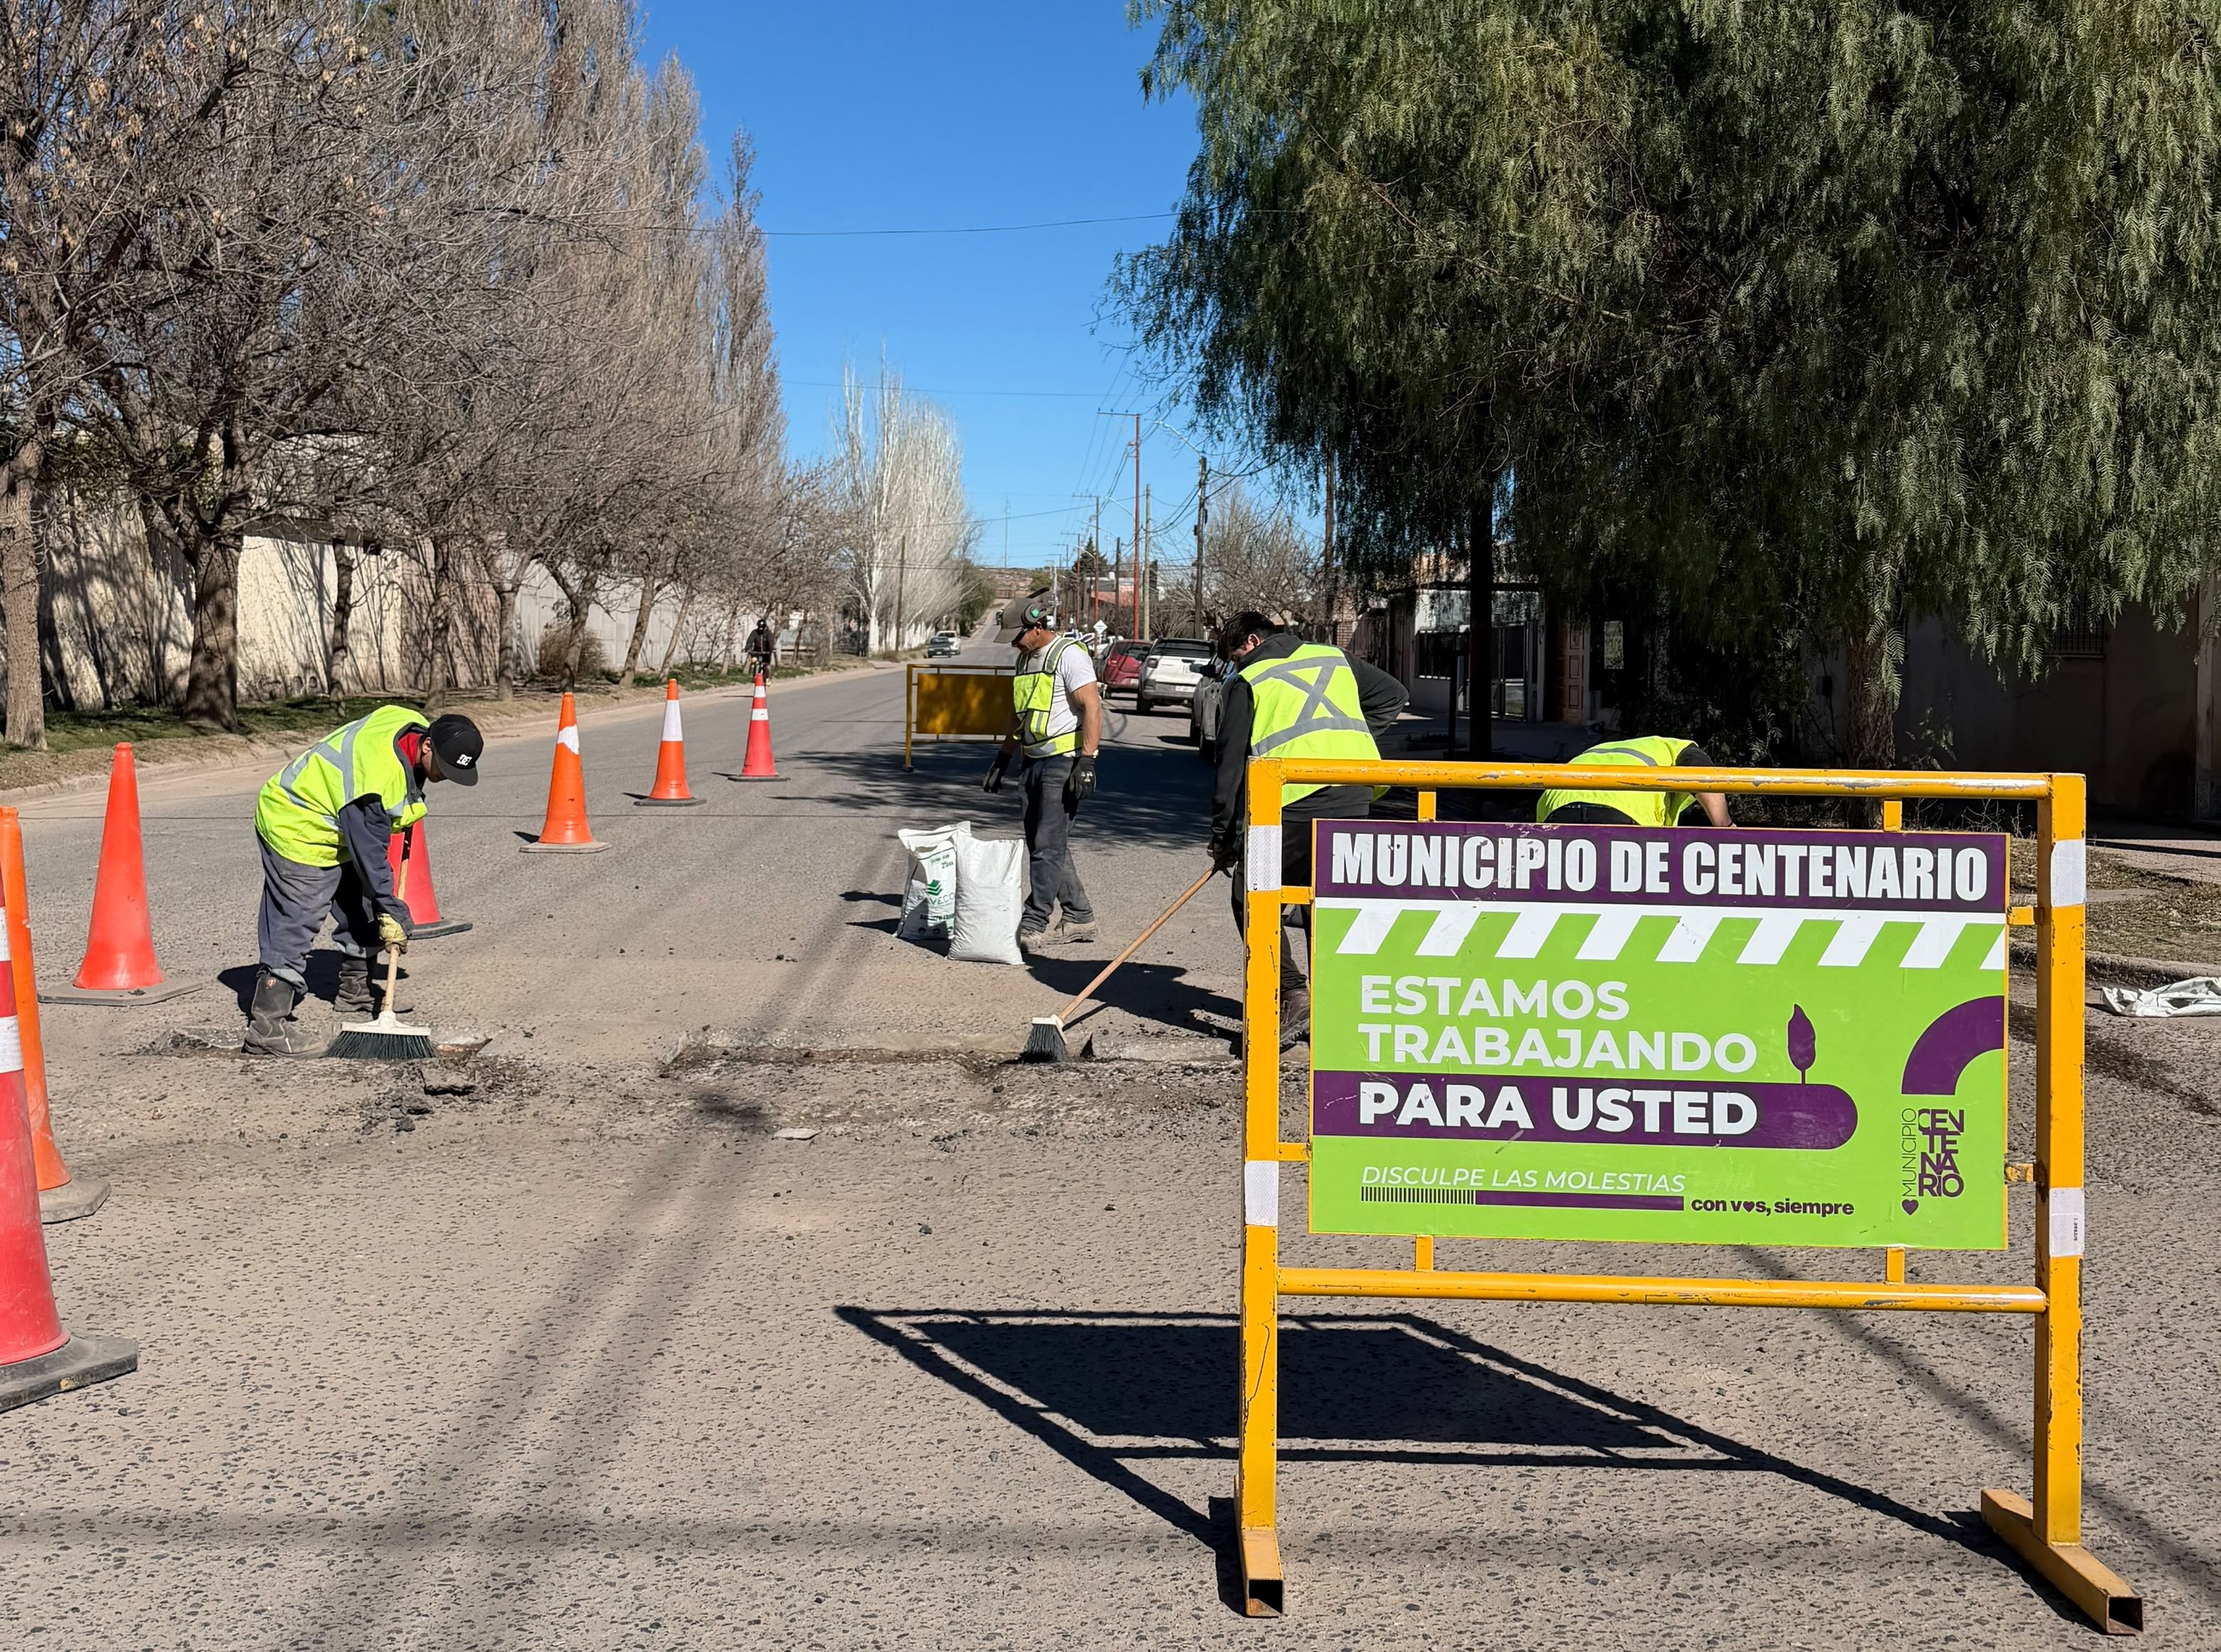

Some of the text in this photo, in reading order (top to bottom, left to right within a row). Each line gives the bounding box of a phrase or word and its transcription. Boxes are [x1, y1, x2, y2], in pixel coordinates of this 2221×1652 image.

[1332, 832, 1988, 901] MUNICIPIO DE CENTENARIO
[1360, 974, 1629, 1021] ESTAMOS
[1358, 1024, 1757, 1073] TRABAJANDO
[1359, 1081, 1758, 1135] PARA USTED
[1901, 1108, 1916, 1196] MUNICIPIO
[1362, 1166, 1686, 1193] DISCULPE LAS MOLESTIAS
[1691, 1199, 1727, 1211] con
[1774, 1198, 1854, 1217] siempre
